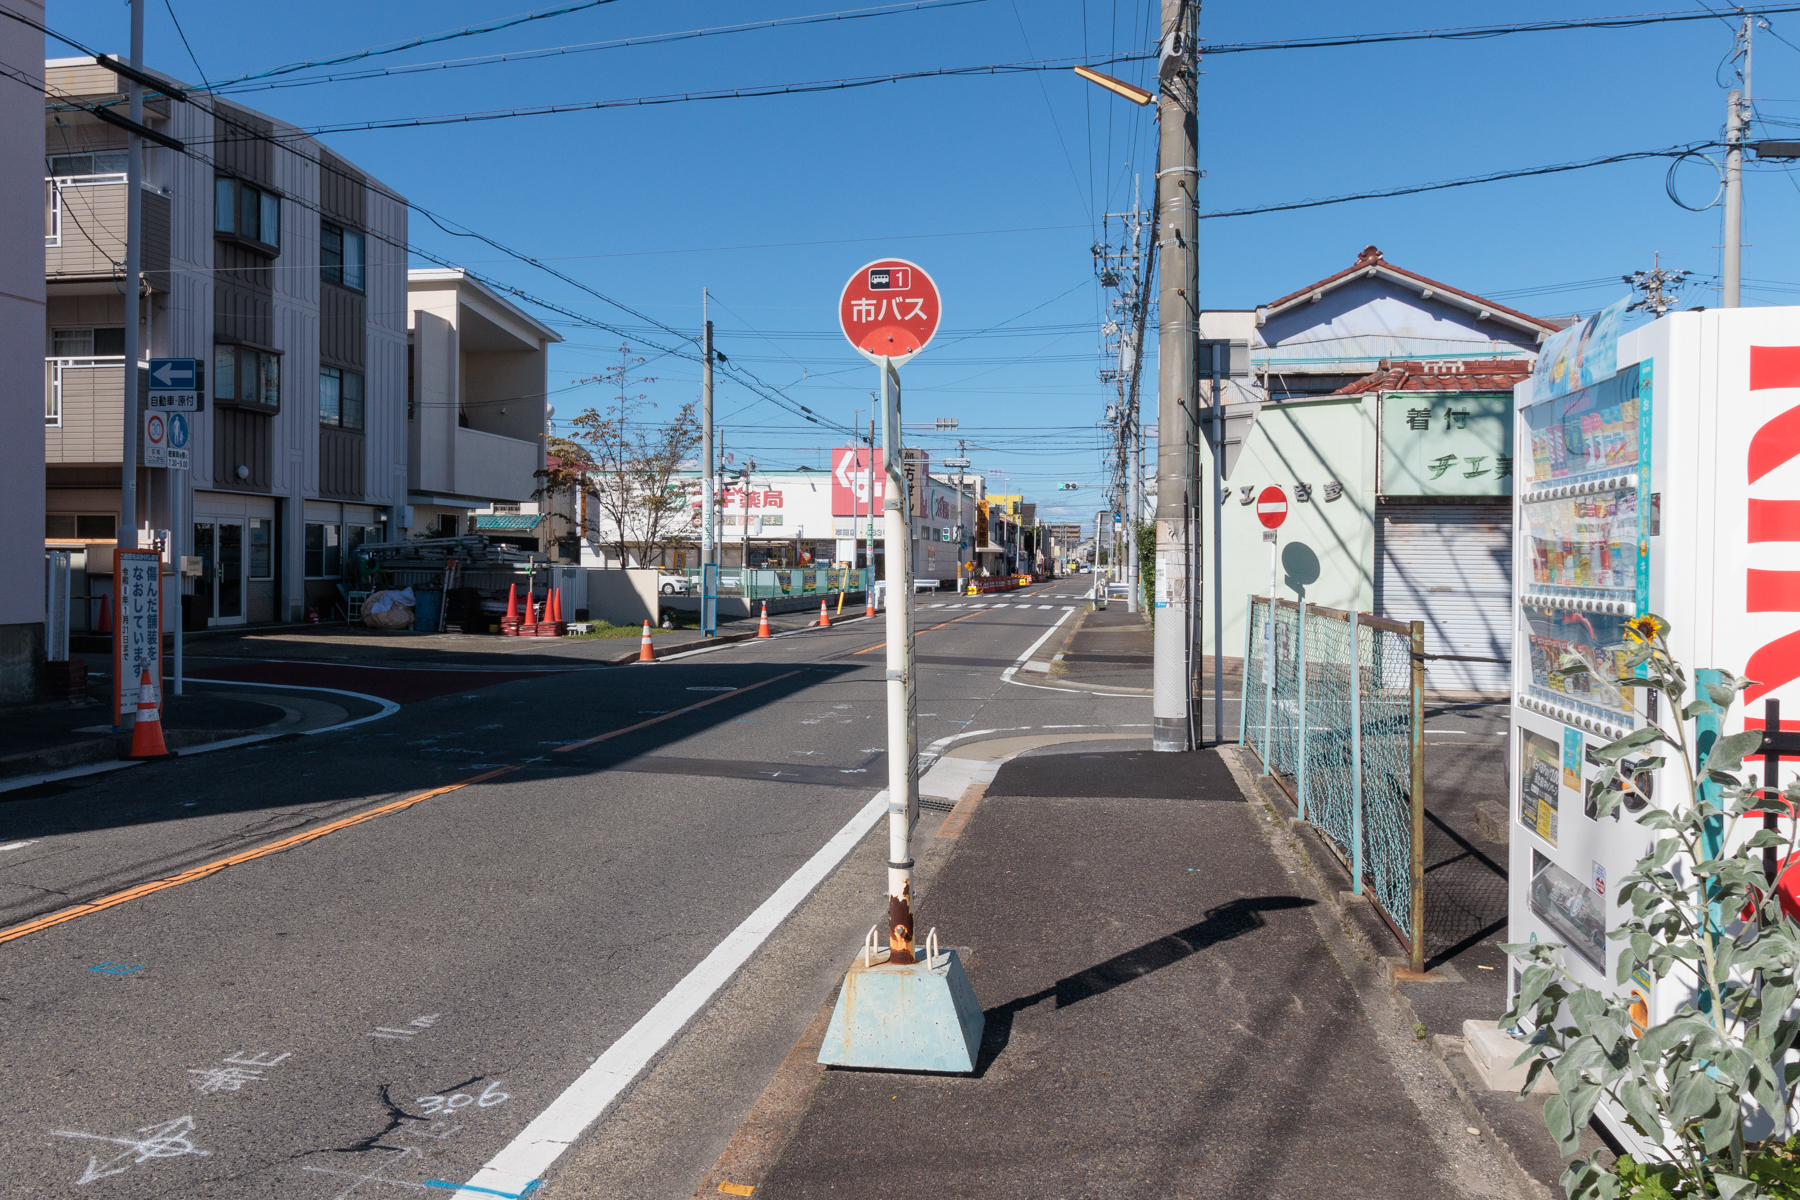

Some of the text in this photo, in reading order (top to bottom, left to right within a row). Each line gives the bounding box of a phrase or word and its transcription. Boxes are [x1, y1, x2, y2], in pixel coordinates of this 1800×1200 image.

[895, 270, 904, 287] 1
[850, 296, 928, 323] 市バス
[150, 395, 195, 407] 自動車・原付
[1405, 406, 1471, 431] 着付
[151, 423, 161, 436] 30
[763, 516, 782, 526] たまご
[133, 565, 144, 678] なおしています
[146, 566, 158, 661] 傷んだ舗装を
